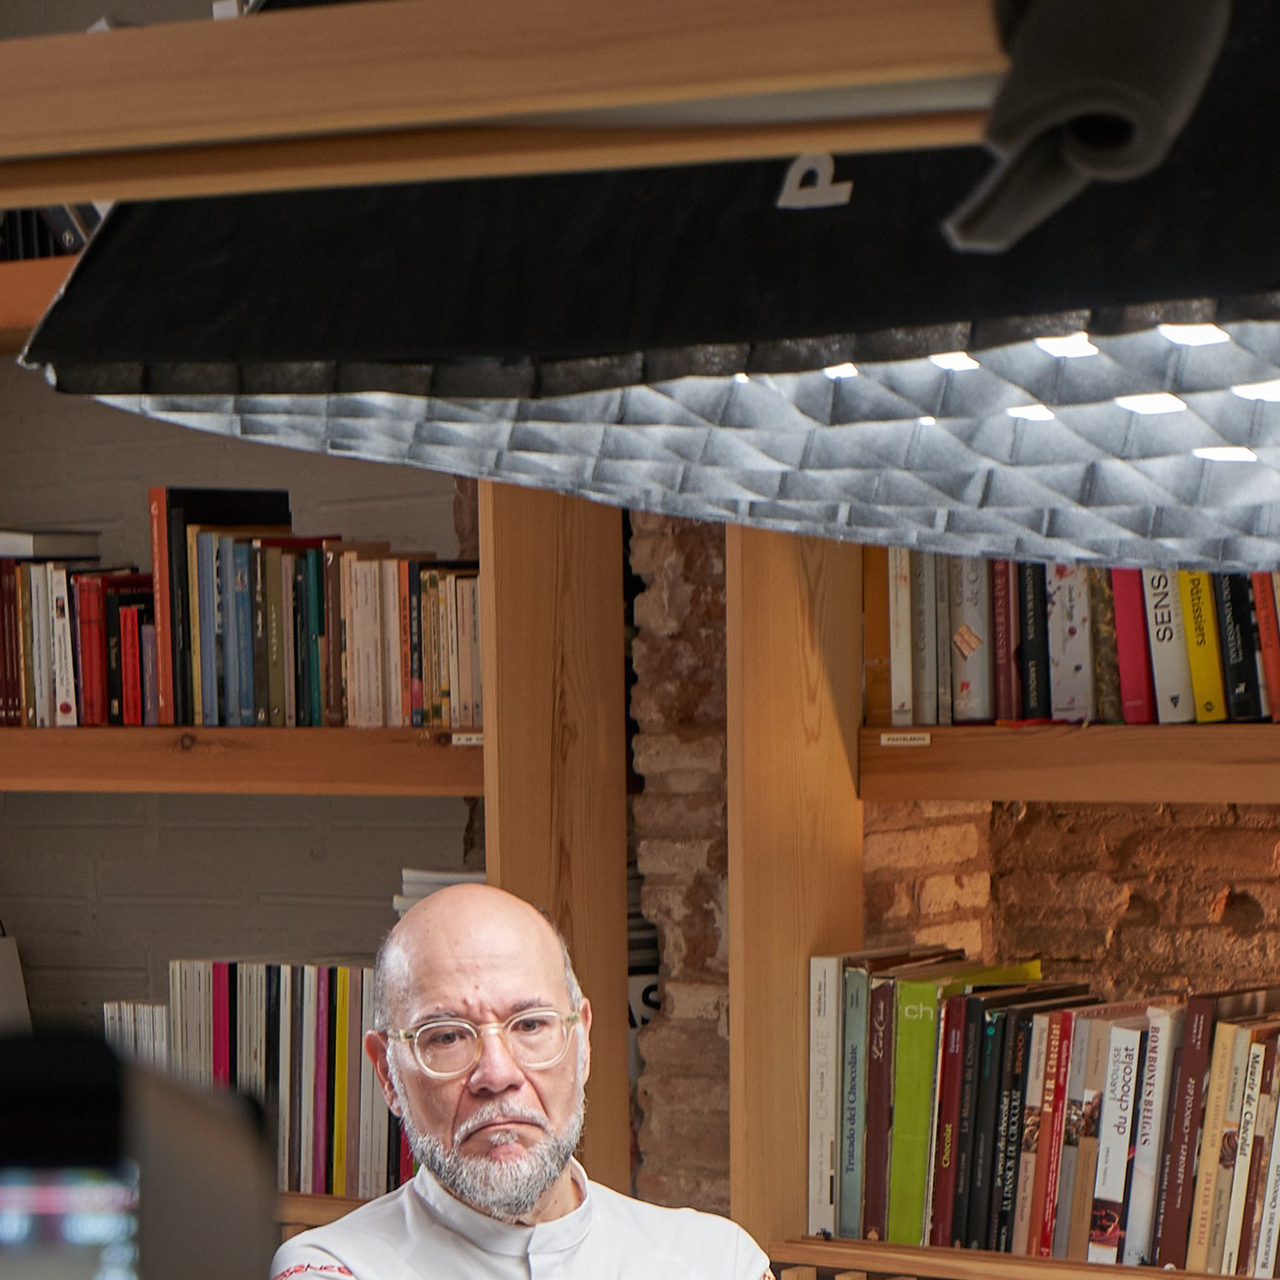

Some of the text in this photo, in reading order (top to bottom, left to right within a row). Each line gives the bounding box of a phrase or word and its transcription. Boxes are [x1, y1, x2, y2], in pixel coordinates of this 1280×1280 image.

[904, 1001, 934, 1020] ch
[1046, 1023, 1061, 1073] Chocolat
[1108, 1046, 1121, 1100] LAROUSSE
[845, 1044, 858, 1173] Tratado del Chocolate
[1043, 1079, 1055, 1113] PUR
[1113, 1045, 1135, 1134] du chocolat
[1139, 1026, 1161, 1147] BOMBONES BELGAS
[1239, 1052, 1260, 1157] Mourir de Chocolat
[1197, 1211, 1209, 1246] PIERRE
